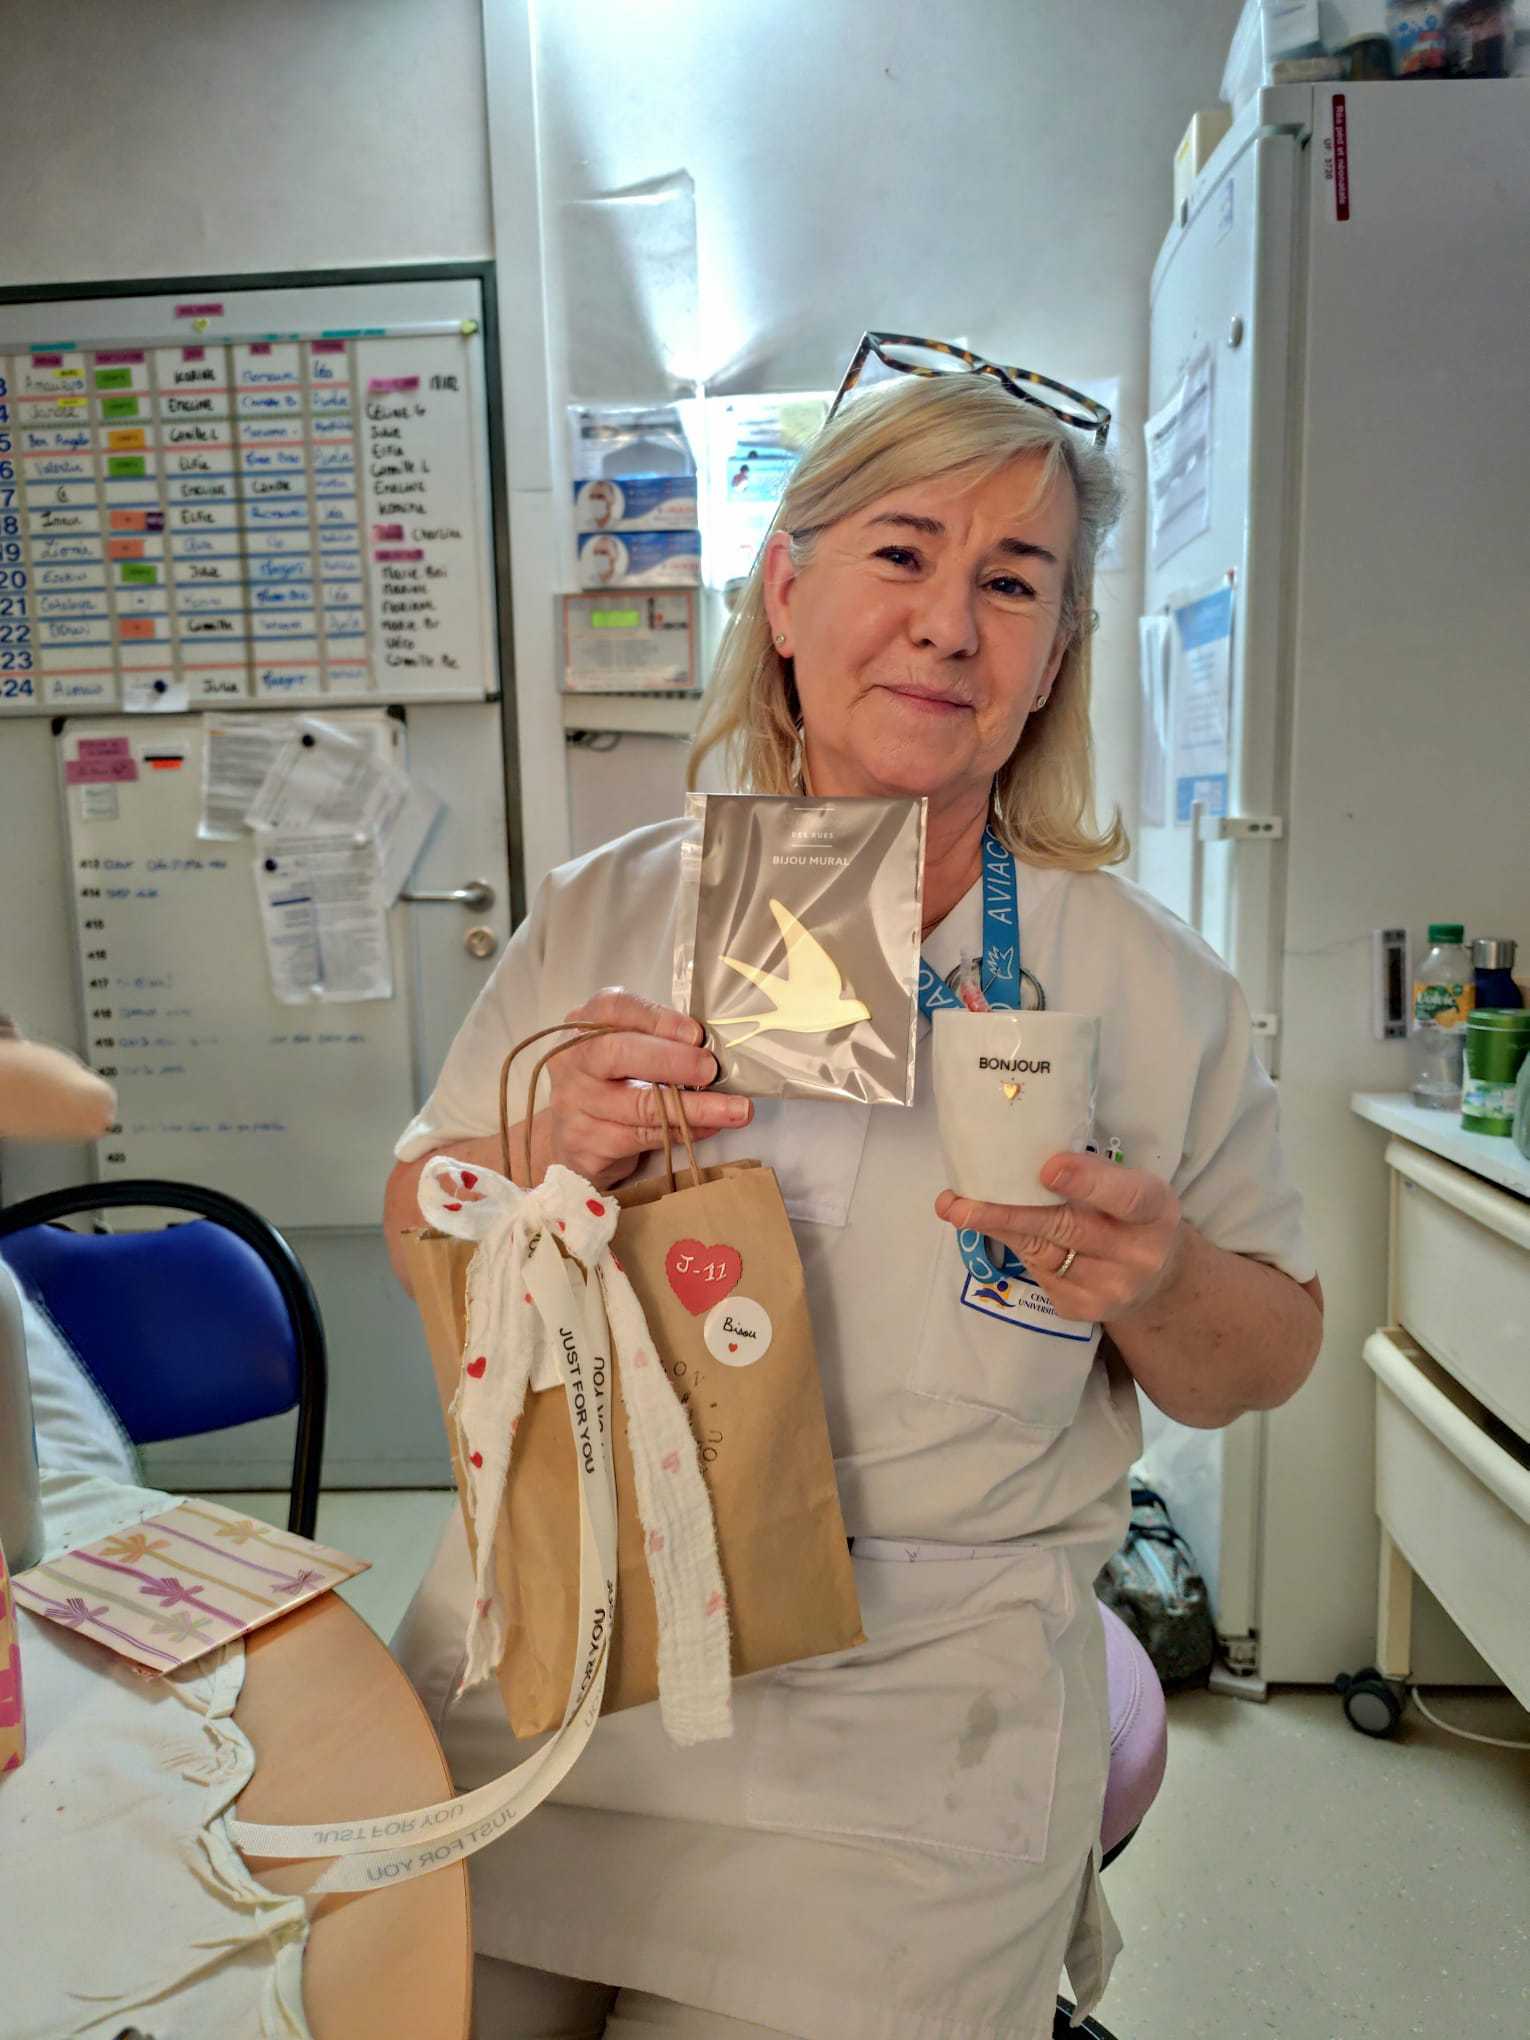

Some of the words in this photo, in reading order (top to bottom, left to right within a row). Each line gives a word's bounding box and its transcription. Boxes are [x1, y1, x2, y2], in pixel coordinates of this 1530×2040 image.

[0, 460, 15, 480] 6
[0, 488, 16, 508] 7
[0, 598, 27, 617] 21
[0, 624, 31, 644] 22
[1, 651, 34, 671] 23
[2, 679, 34, 698] 24
[772, 855, 806, 866] BIJOU
[811, 856, 850, 866] MURAL
[979, 1056, 1051, 1073] BONJOUR
[722, 1316, 757, 1340] Bisou
[559, 1327, 581, 1376] JUST
[572, 1380, 588, 1426] FOR
[581, 1427, 596, 1475] YOU
